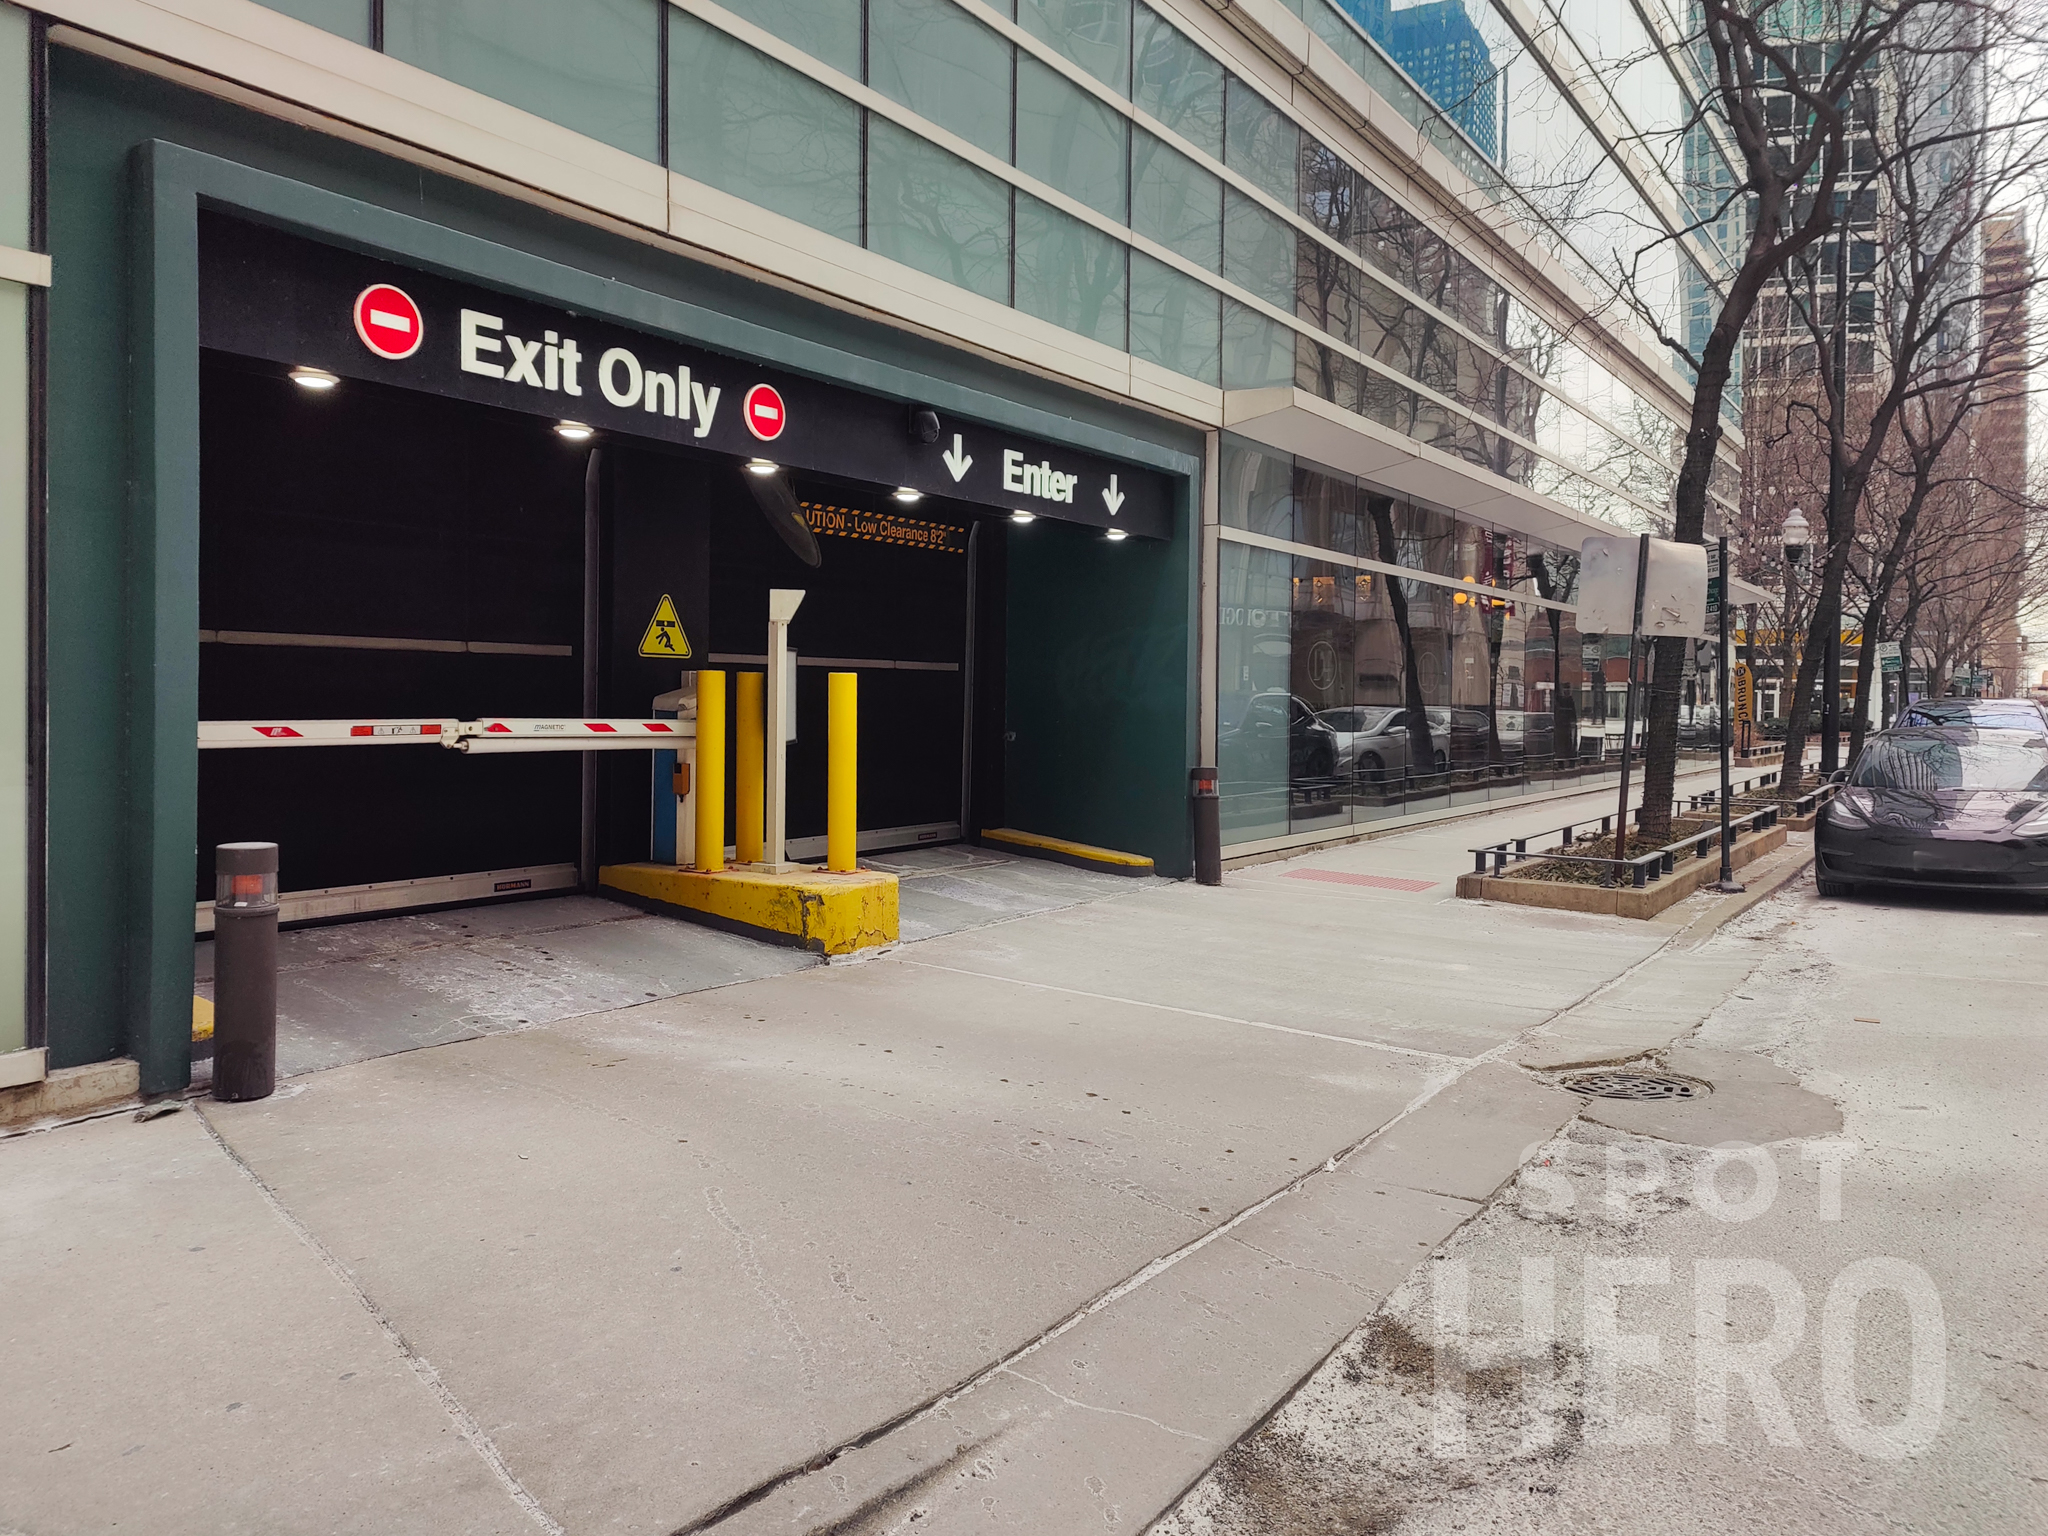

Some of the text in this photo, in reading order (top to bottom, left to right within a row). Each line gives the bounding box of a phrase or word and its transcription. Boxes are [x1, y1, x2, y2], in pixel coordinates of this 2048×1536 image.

[460, 308, 721, 439] Exit Only
[1003, 448, 1078, 504] Enter
[805, 509, 846, 530] UTION
[854, 516, 877, 535] Low
[879, 520, 929, 543] Clearance
